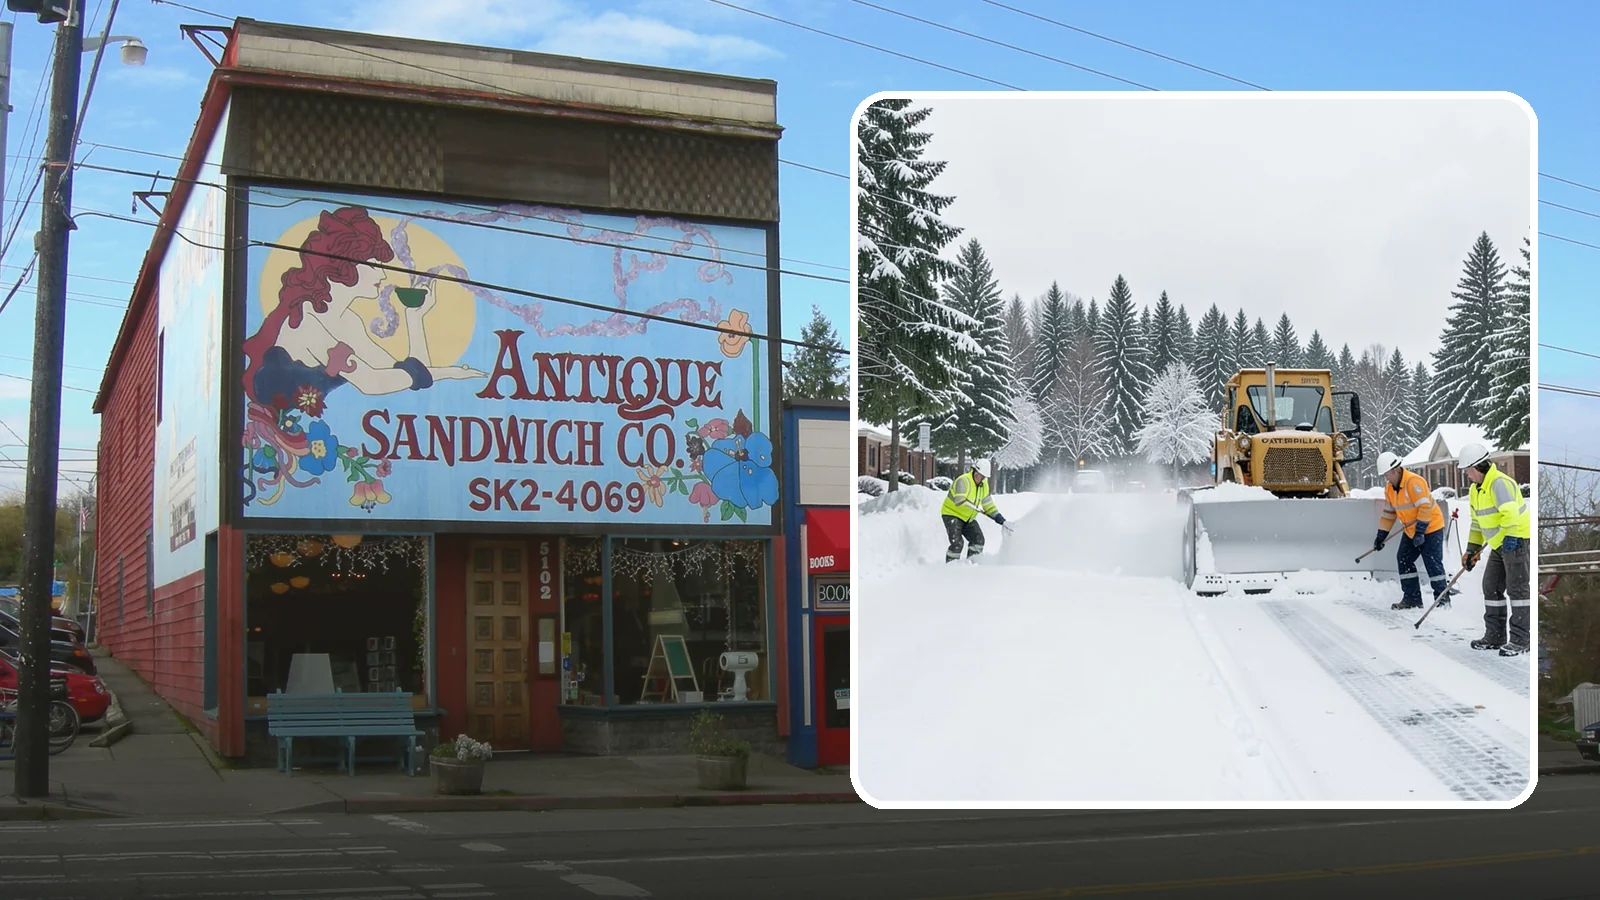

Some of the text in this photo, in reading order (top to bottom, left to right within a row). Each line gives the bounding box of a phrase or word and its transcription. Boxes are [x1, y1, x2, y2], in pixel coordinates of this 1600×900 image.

[475, 329, 723, 421] ANTIQUE
[361, 408, 685, 469] SANDWICH CO.
[469, 477, 646, 513] SK2-4069
[540, 541, 551, 600] 5102
[809, 555, 835, 569] BOOKS
